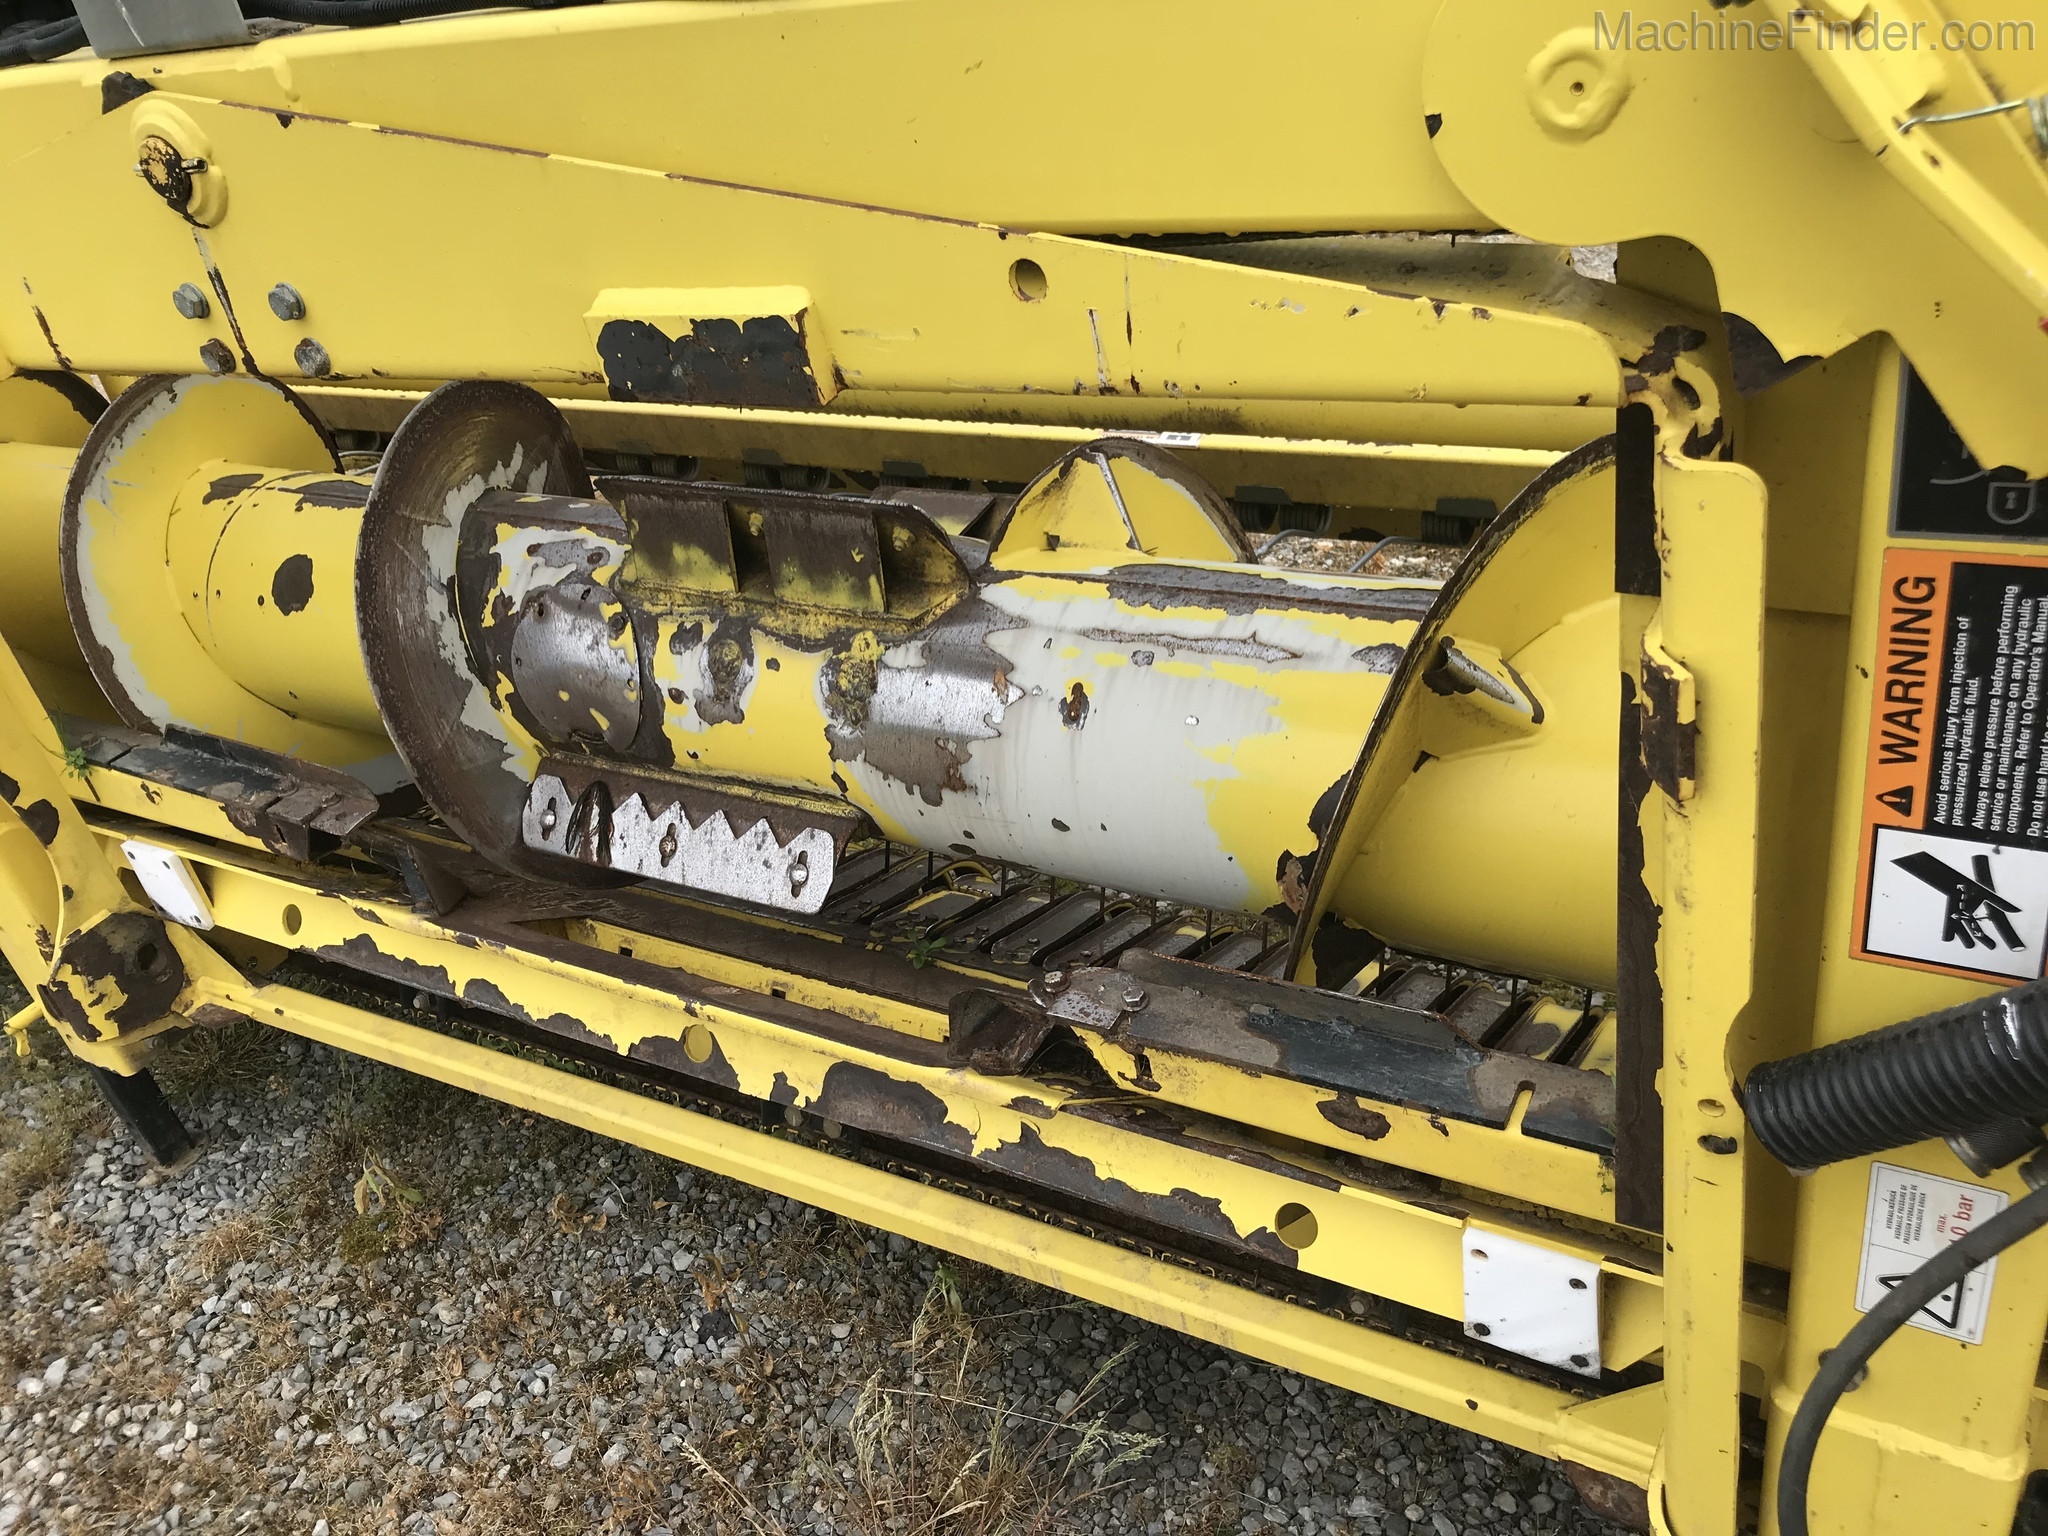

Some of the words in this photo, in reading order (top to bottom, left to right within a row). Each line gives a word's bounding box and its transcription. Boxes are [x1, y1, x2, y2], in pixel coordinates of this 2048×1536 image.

[1956, 616, 1969, 630] of
[1996, 585, 2018, 654] performing
[2011, 598, 2032, 655] hydraulic
[1878, 576, 1936, 764] WARNING
[1949, 633, 1967, 683] injection
[2011, 658, 2026, 680] any
[1964, 677, 1979, 705] fluid.
[1988, 656, 2006, 695] before
[2008, 683, 2020, 698] on
[2021, 646, 2043, 710] Operator's
[1946, 687, 1960, 714] from
[1942, 716, 1959, 748] injury
[1957, 708, 1975, 760] hydraulic
[1984, 698, 2000, 749] pressure
[2020, 712, 2033, 725] to
[1997, 701, 2017, 775] maintenance
[2014, 728, 2031, 759] Refer
[1938, 750, 1953, 791] serious
[1978, 751, 1993, 788] relieve
[2035, 745, 2048, 775] hand
[1951, 762, 1969, 826] pressurized
[1996, 777, 2006, 790] or
[2006, 762, 2025, 834] components.
[2035, 777, 2047, 798] use
[1933, 793, 1948, 824] Avoid
[1971, 791, 1989, 830] Always
[1990, 792, 2004, 832] service
[2031, 800, 2044, 819] not
[2026, 821, 2040, 837] Do
[1897, 1191, 1907, 1214] PRESSURE
[1952, 1194, 1974, 1222] bar
[1936, 1213, 1948, 1233] max.
